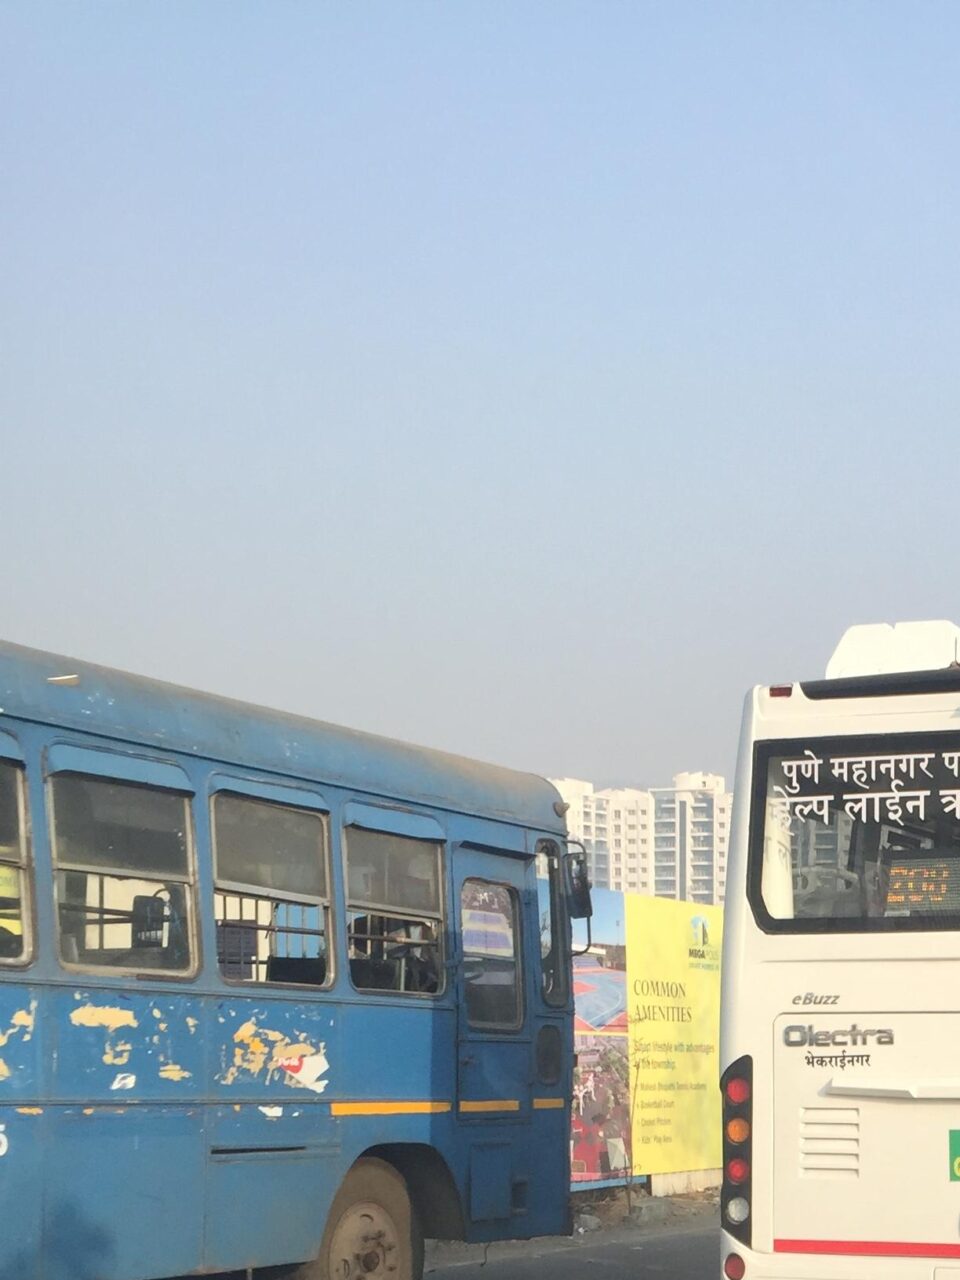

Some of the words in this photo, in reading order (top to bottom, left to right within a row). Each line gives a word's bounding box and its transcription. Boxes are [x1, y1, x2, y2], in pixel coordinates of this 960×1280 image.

[781, 750, 823, 794] पुणे
[830, 753, 935, 789] महानगर
[768, 785, 835, 835] हेल्प
[842, 779, 931, 826] लाईन
[634, 979, 687, 998] COMMON
[791, 992, 840, 1006] eBuzz
[634, 1004, 693, 1023] AMENITIES
[783, 1024, 894, 1047] Olectra
[804, 1049, 871, 1070] भेकराईनगर
